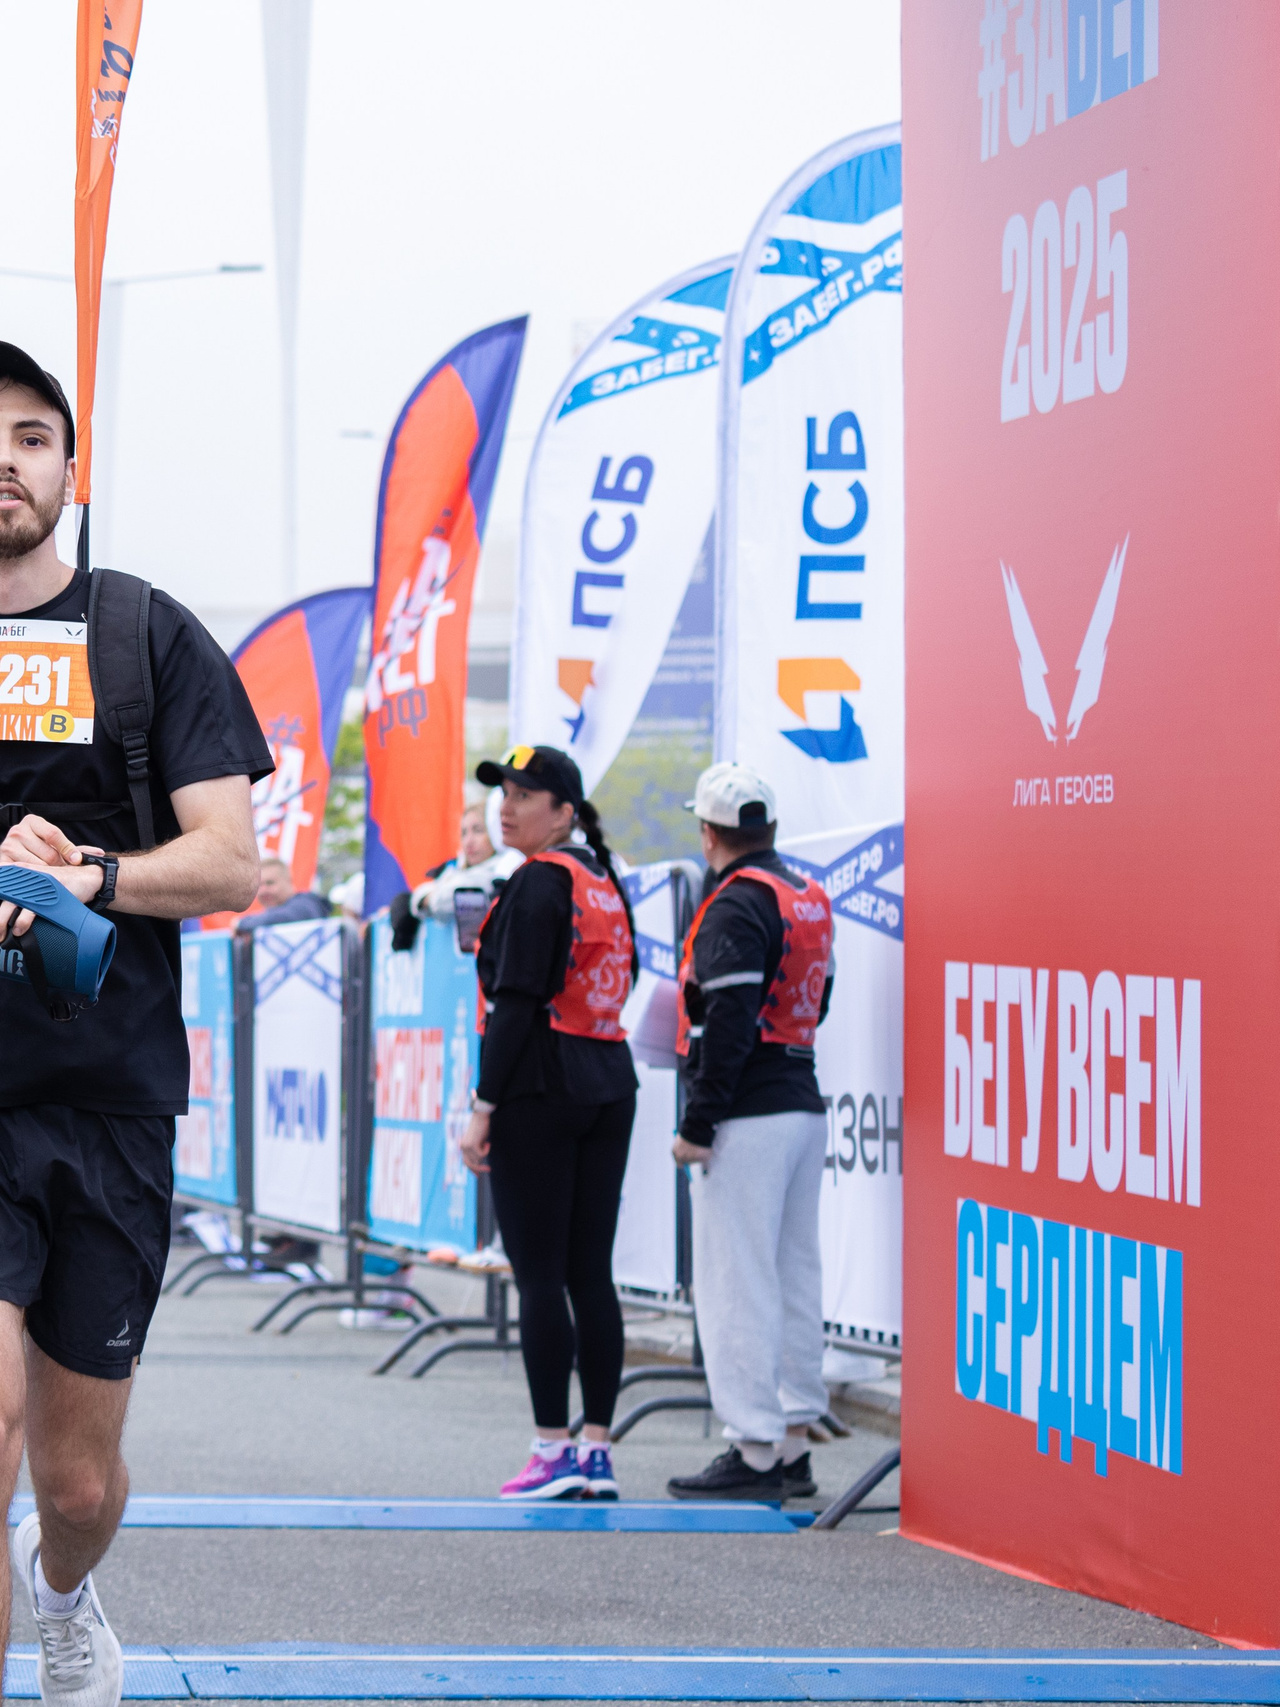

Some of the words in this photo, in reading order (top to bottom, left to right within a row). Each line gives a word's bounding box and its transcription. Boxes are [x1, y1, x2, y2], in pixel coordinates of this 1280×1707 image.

[591, 345, 721, 397] ЗАБЕГ.
[1000, 168, 1129, 424] 2025
[572, 455, 655, 628] ПСБ
[795, 410, 869, 620] ПСБ
[1013, 778, 1051, 807] ЛИГА
[1055, 774, 1114, 805] ГЕРОЕВ
[944, 960, 1050, 1174] БЕГУ
[1058, 969, 1201, 1208] ВСЕМ
[956, 1197, 1183, 1478] СЕРДЦЕМ
